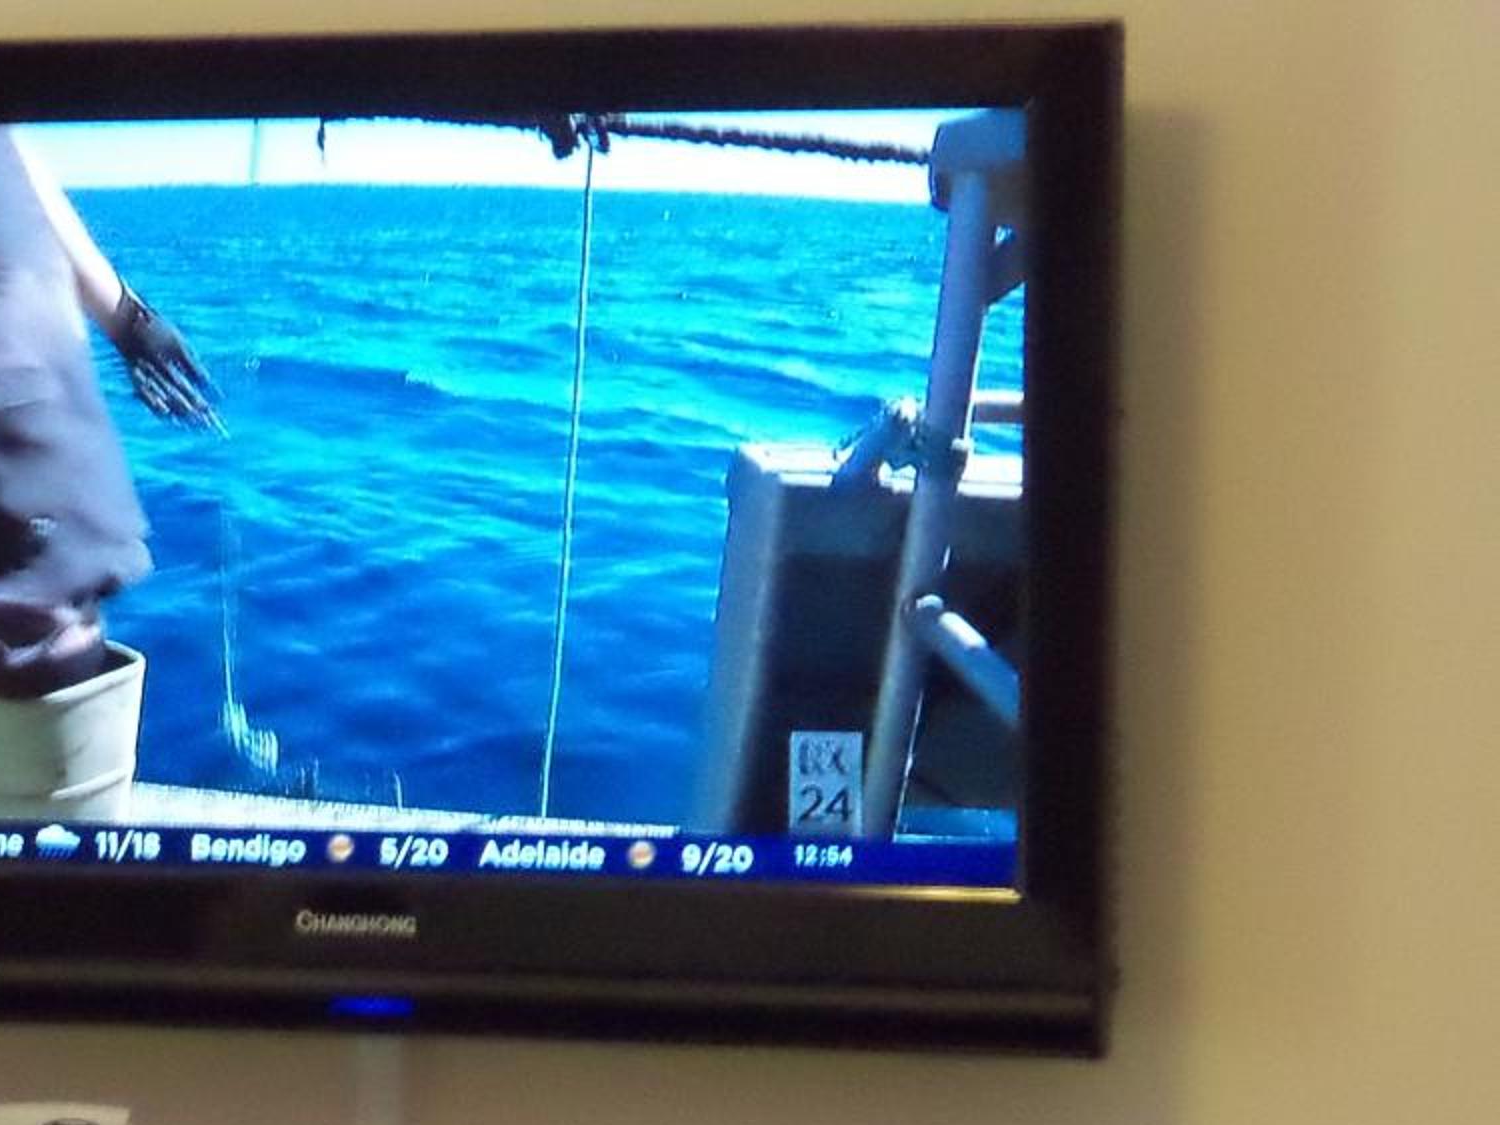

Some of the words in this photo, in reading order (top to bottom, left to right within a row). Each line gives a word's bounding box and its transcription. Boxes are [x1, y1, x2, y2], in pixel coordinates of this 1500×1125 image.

[799, 784, 853, 824] 24
[191, 833, 307, 868] Bendigo
[479, 840, 606, 869] Adelaide
[681, 842, 753, 874] 9/20
[794, 844, 854, 868] 12:54
